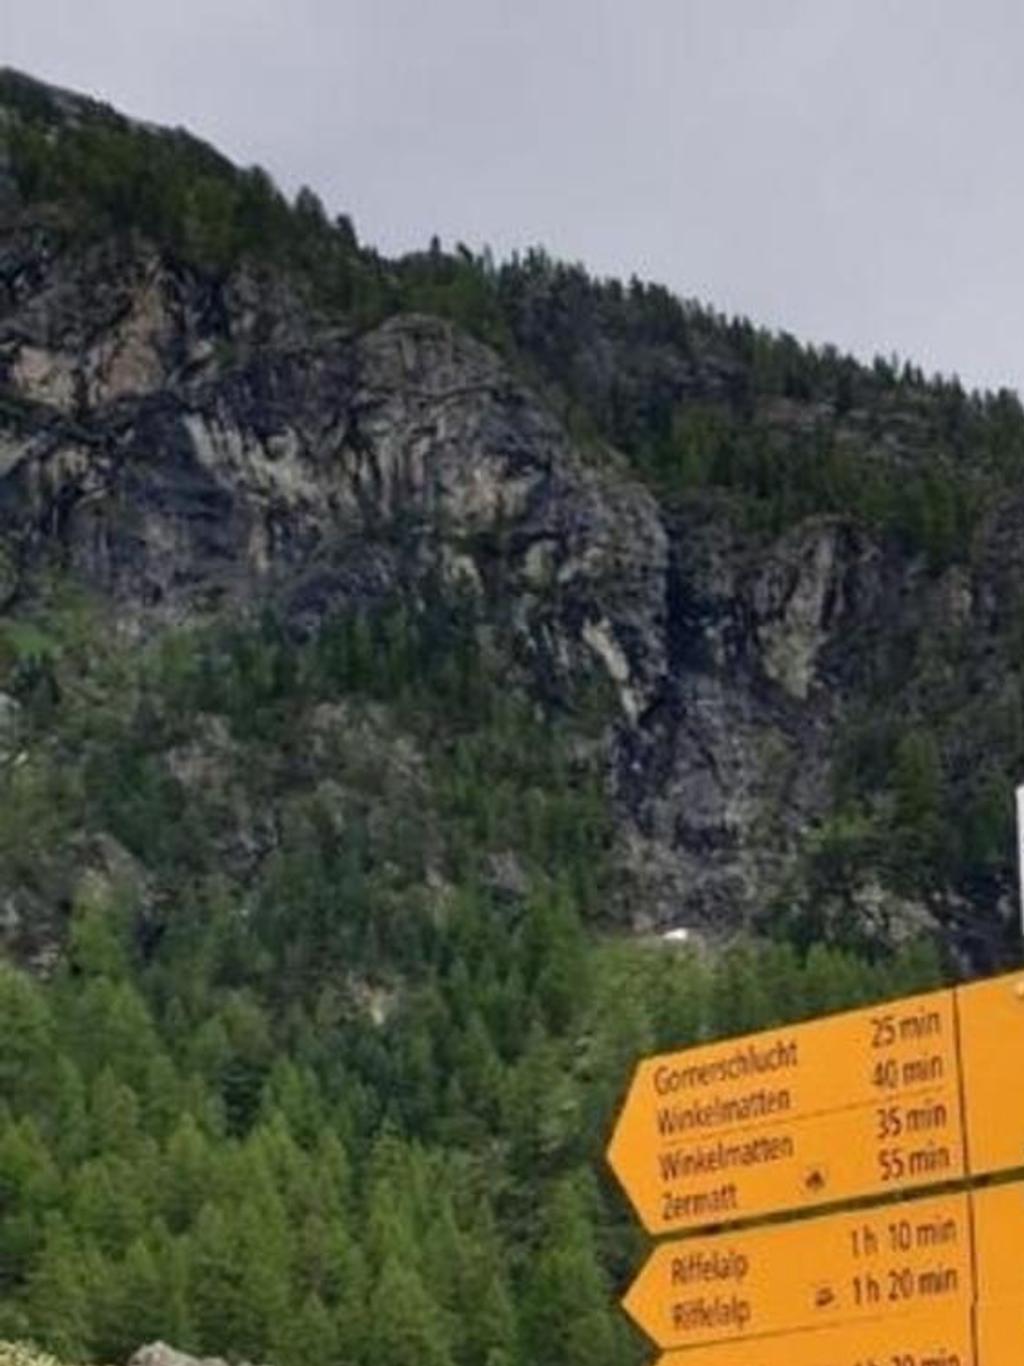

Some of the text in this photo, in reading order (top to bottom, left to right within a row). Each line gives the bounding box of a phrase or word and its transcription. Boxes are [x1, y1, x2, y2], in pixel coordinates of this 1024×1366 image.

[870, 1014, 896, 1049] 25
[899, 1005, 941, 1042] min
[656, 1051, 943, 1136] Winkelmatten 40 min
[658, 1097, 947, 1182] Winkelmatten 35 min
[661, 1138, 950, 1221] Zermatt 55 min
[851, 1229, 860, 1259] 1
[863, 1224, 879, 1256] h
[887, 1219, 912, 1252] 10
[915, 1213, 957, 1247] min
[852, 1276, 862, 1306] 1
[865, 1272, 881, 1303] h
[887, 1266, 914, 1301] 20
[917, 1262, 958, 1295] min
